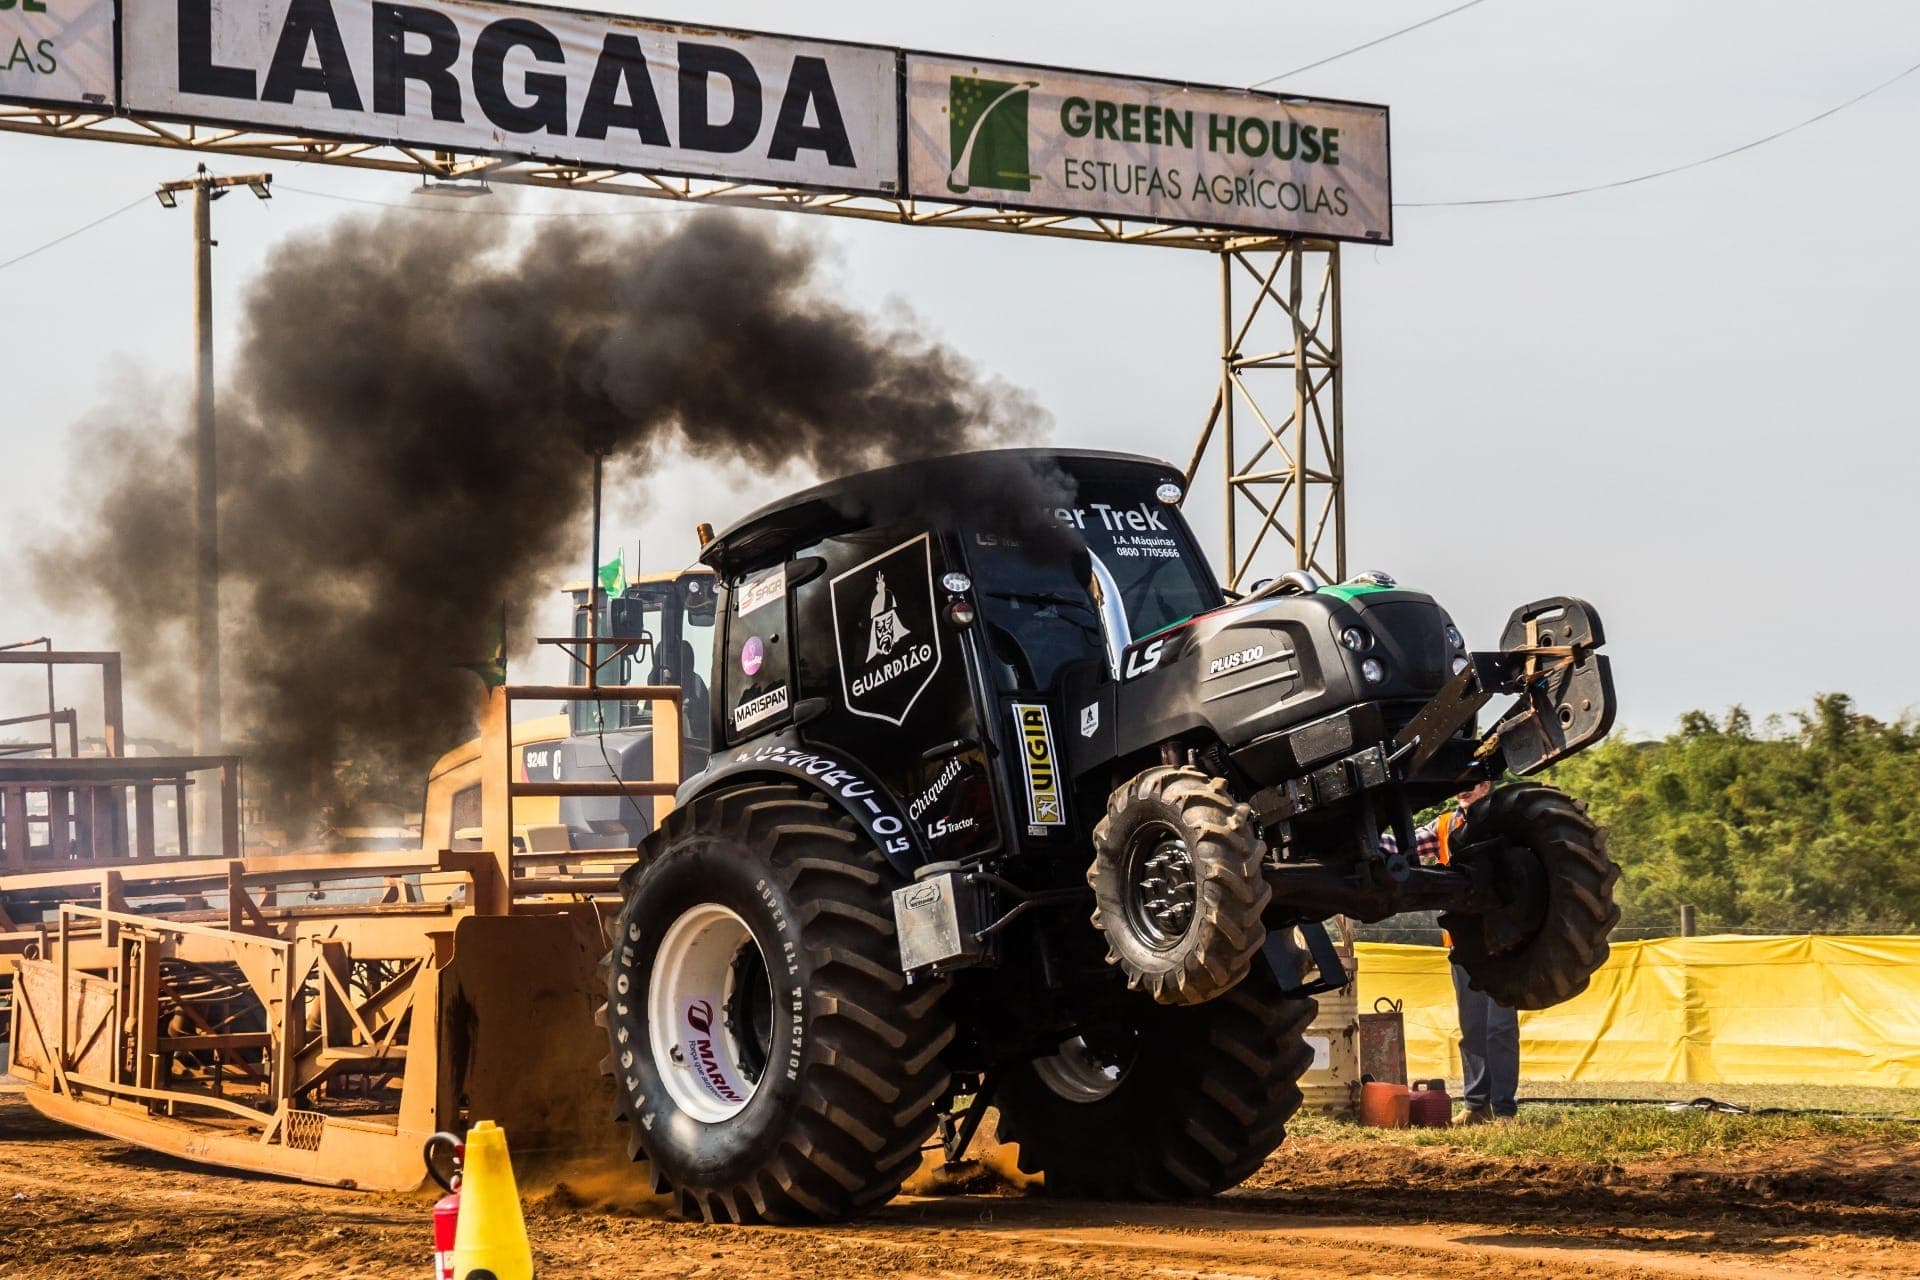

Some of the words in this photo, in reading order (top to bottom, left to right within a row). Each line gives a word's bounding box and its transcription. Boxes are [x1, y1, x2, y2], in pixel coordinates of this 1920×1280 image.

[0, 36, 57, 75] AS
[178, 0, 857, 168] LARGADA
[1060, 96, 1193, 149] GREEN
[1208, 113, 1340, 165] HOUSE
[1064, 158, 1181, 199] ESTUFAS
[1192, 170, 1349, 217] AGRÍCOLAS
[1090, 502, 1168, 531] Trek
[1112, 535, 1130, 545] J.A.
[1131, 535, 1176, 548] Máquinas
[1116, 547, 1140, 557] 0800
[1141, 548, 1180, 558] 7705666
[852, 644, 932, 697] GUARDIÃO
[1125, 640, 1164, 679] LS
[1210, 652, 1240, 674] PLUS
[1239, 645, 1264, 664] 100
[736, 689, 786, 723] MARISPAN
[527, 750, 548, 768] 924K
[909, 756, 962, 820] Chiquetti
[886, 837, 910, 854] LS
[927, 818, 947, 839] LS
[947, 817, 974, 833] Tractor
[756, 879, 787, 932] SUPER
[783, 941, 800, 976] ALL
[786, 986, 803, 1081] TRACTION
[697, 1040, 746, 1102] MARINI
